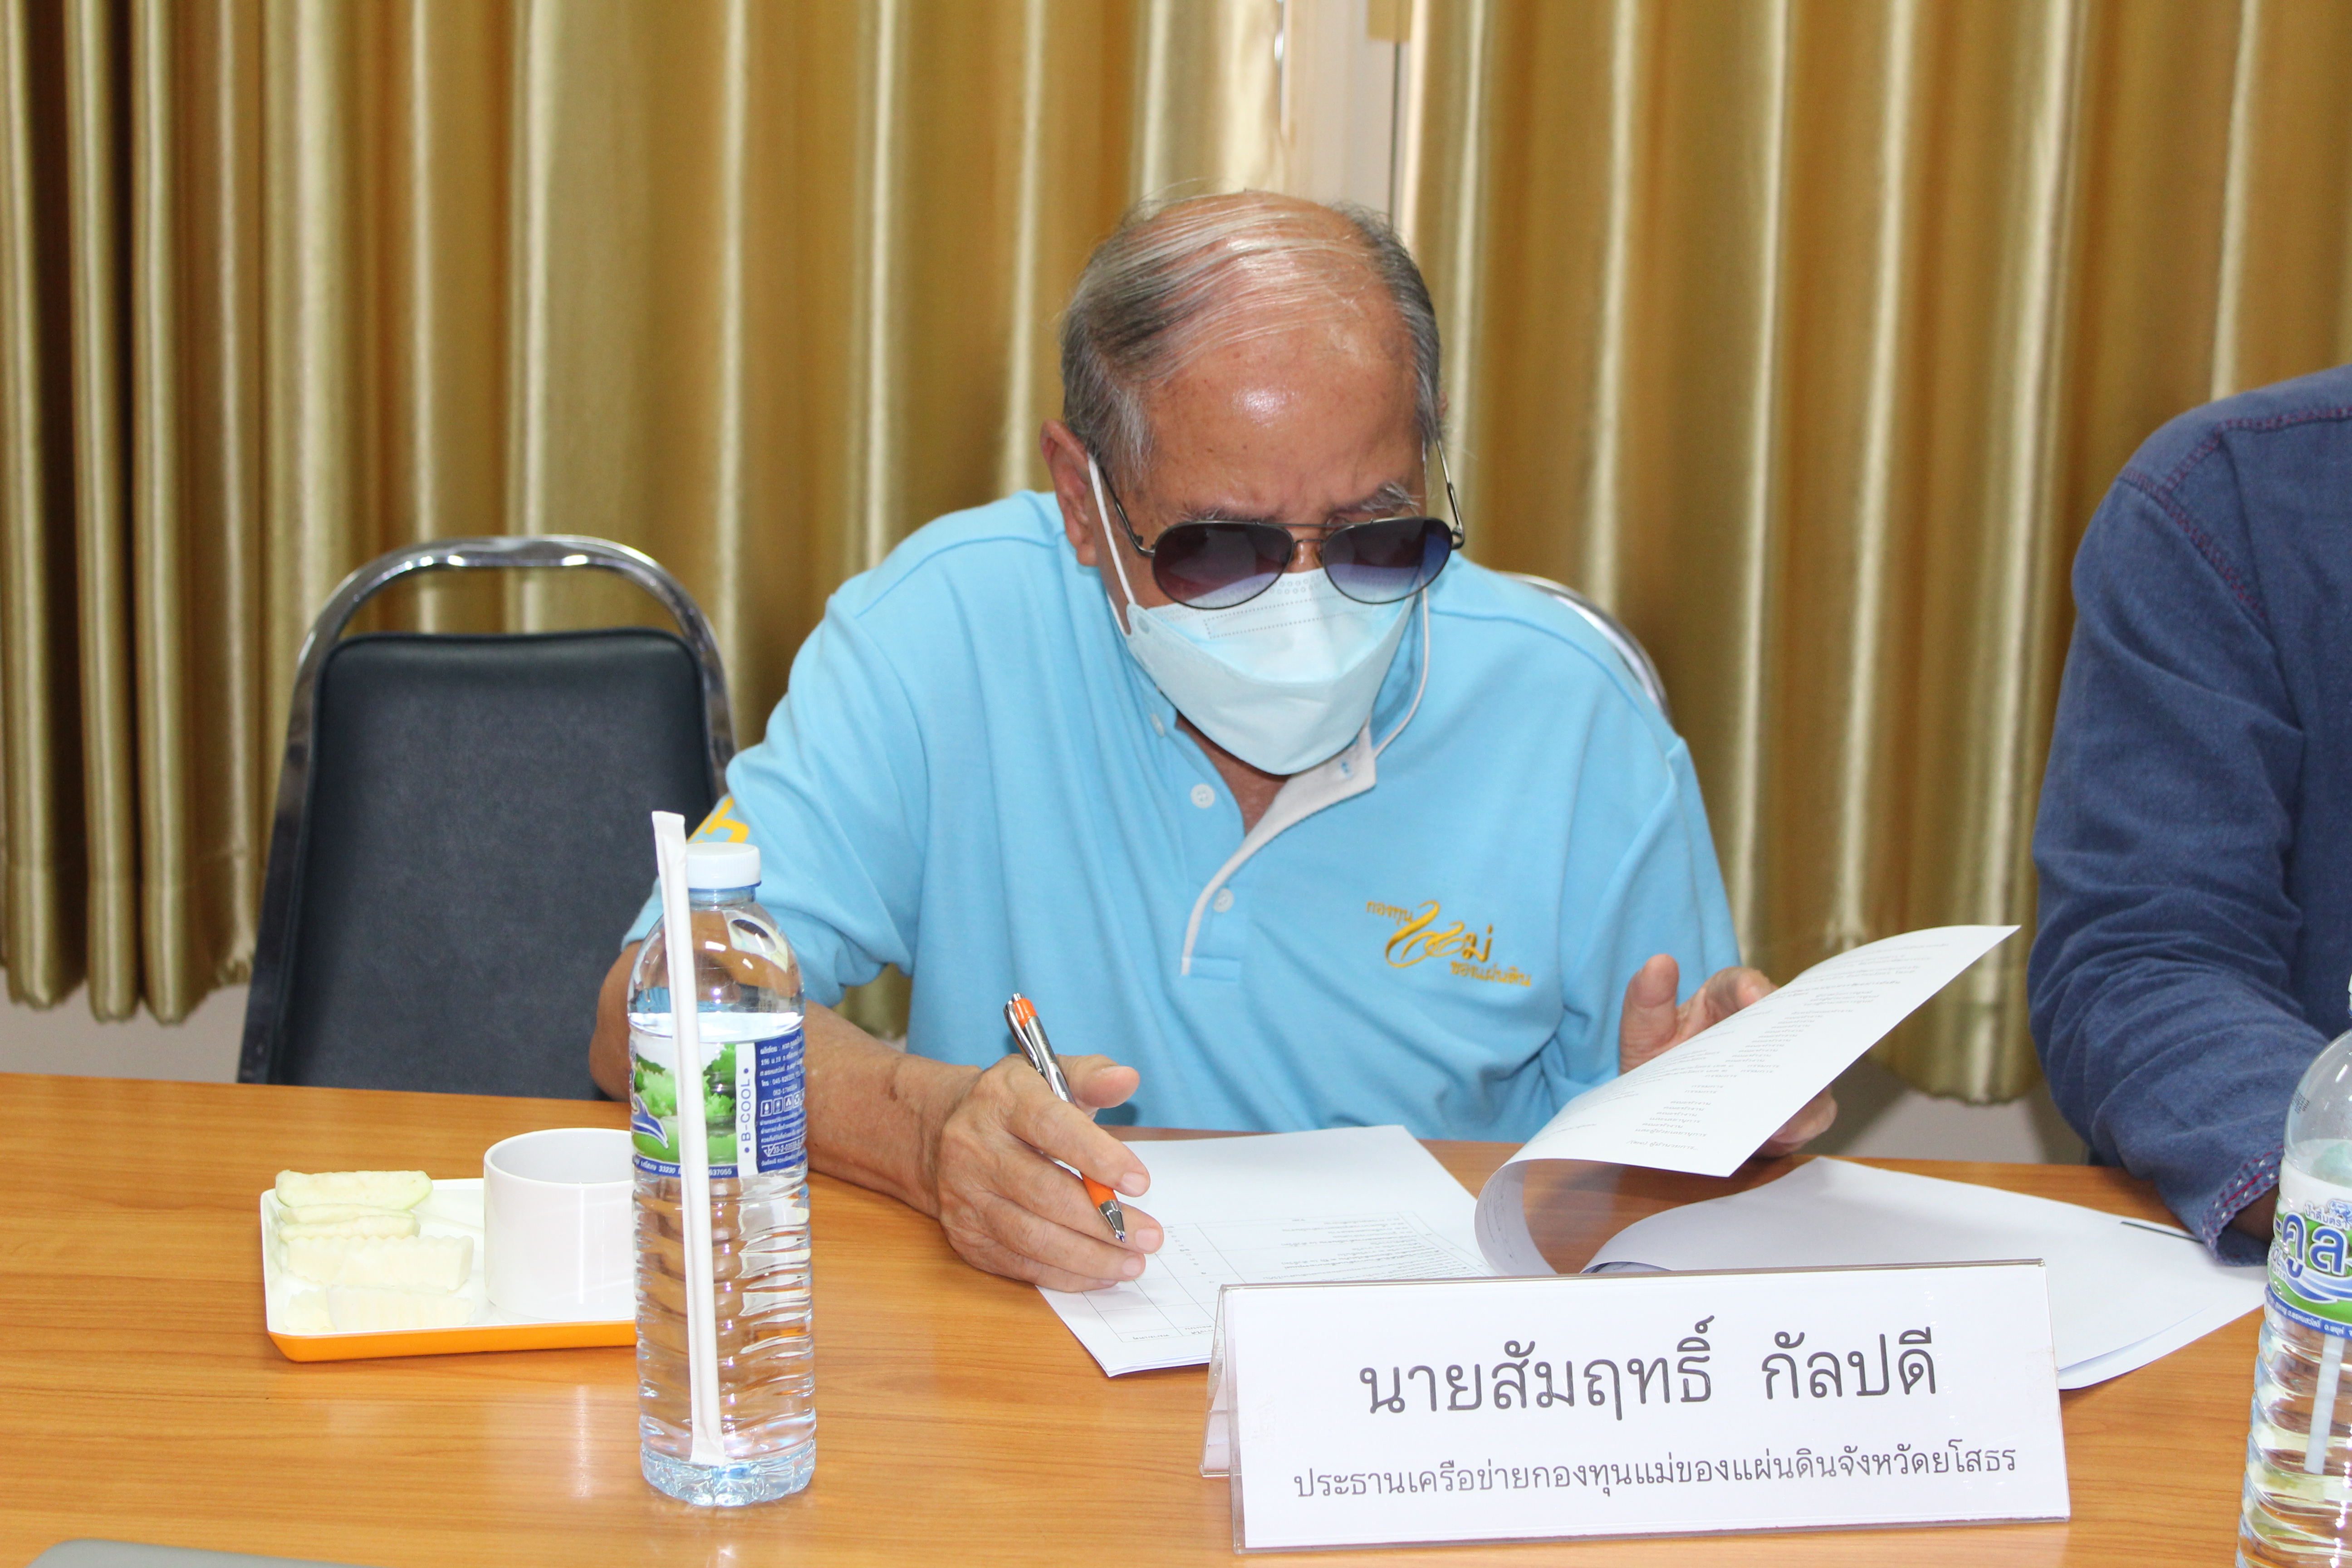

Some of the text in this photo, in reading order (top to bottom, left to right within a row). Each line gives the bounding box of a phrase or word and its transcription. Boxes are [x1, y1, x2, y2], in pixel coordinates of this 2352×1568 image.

[1367, 900, 1413, 926] กองทุน
[1450, 961, 1531, 987] ของแผ่นดิน
[741, 1078, 751, 1142] B-COOL
[658, 1165, 676, 1174] 33230
[2275, 1213, 2345, 1279] -คูล
[1359, 1315, 1936, 1421] นายสัมฤทธิ์ กัลปดี
[1294, 1439, 2016, 1497] ประธานเครือข่ายกองทุนแม่ของแผ่นดินจังหวัดยโสธร
